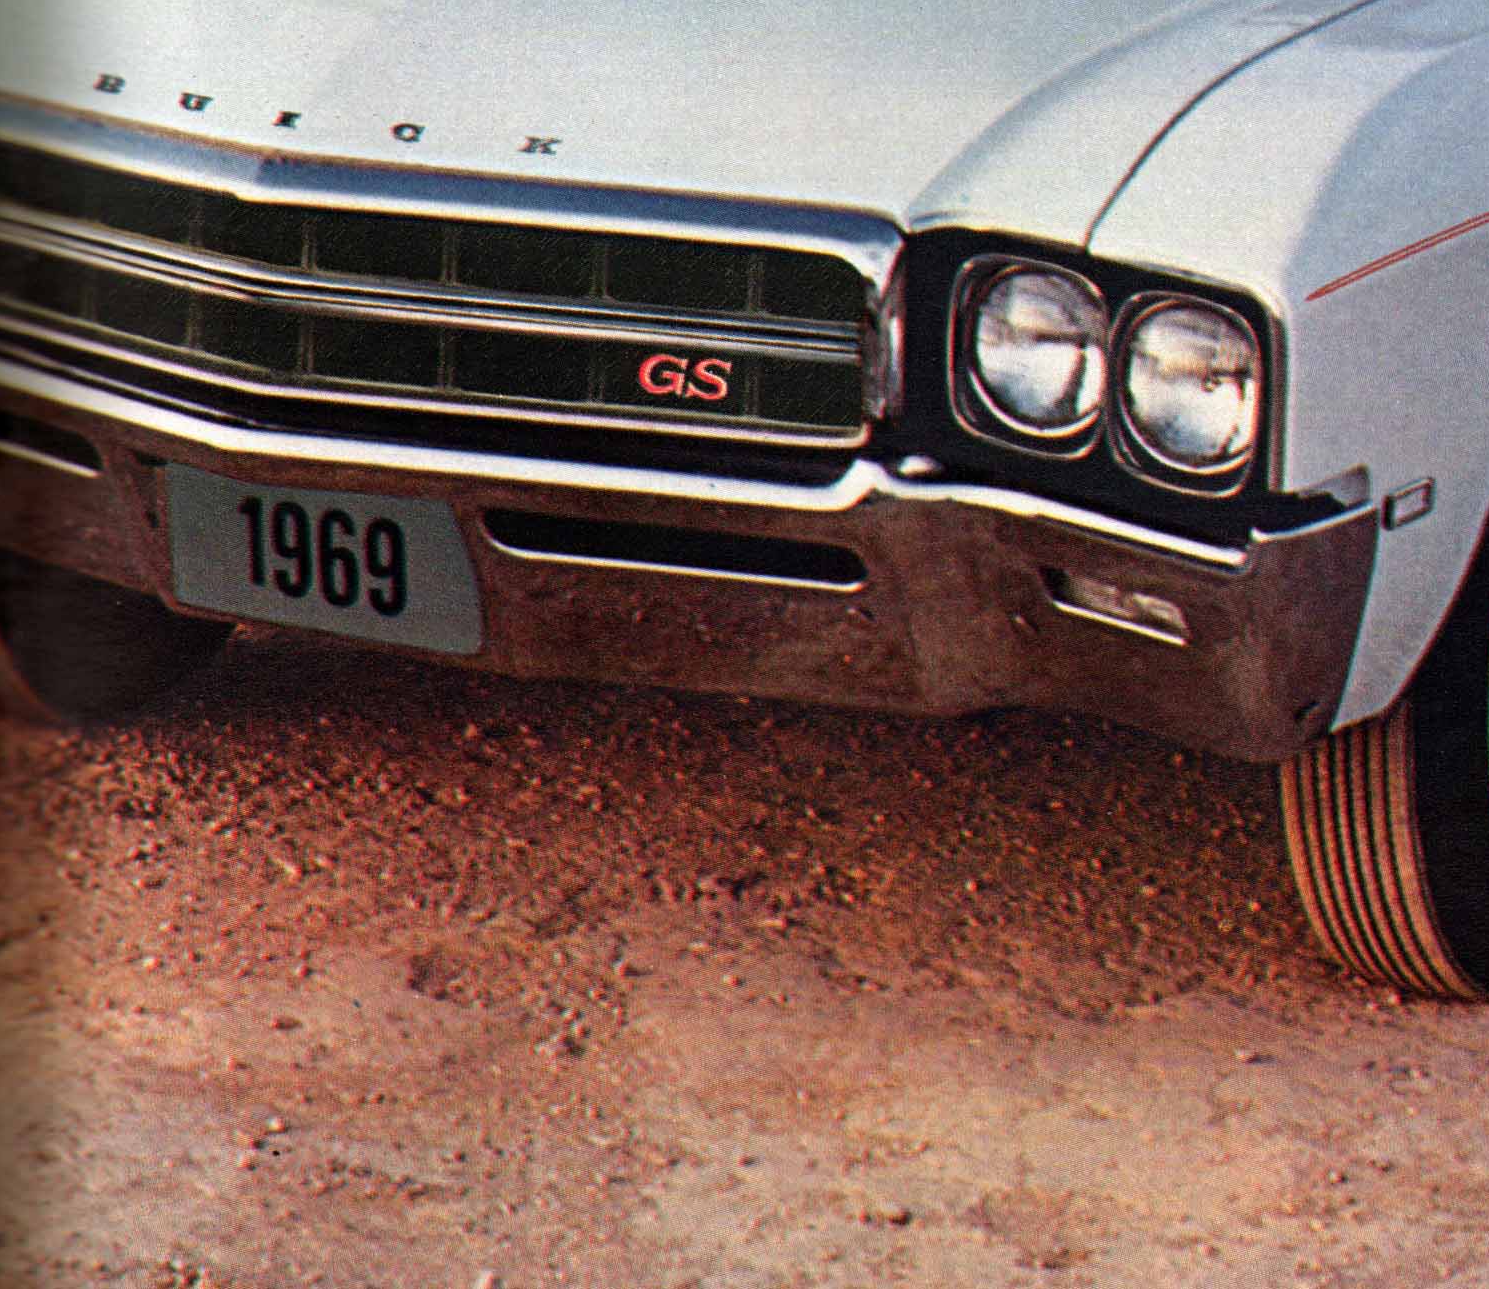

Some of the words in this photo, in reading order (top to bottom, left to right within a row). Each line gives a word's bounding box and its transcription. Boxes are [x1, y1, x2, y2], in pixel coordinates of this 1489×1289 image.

[93, 73, 561, 156] BUICK
[638, 353, 733, 401] GS
[238, 496, 408, 617] 1969
